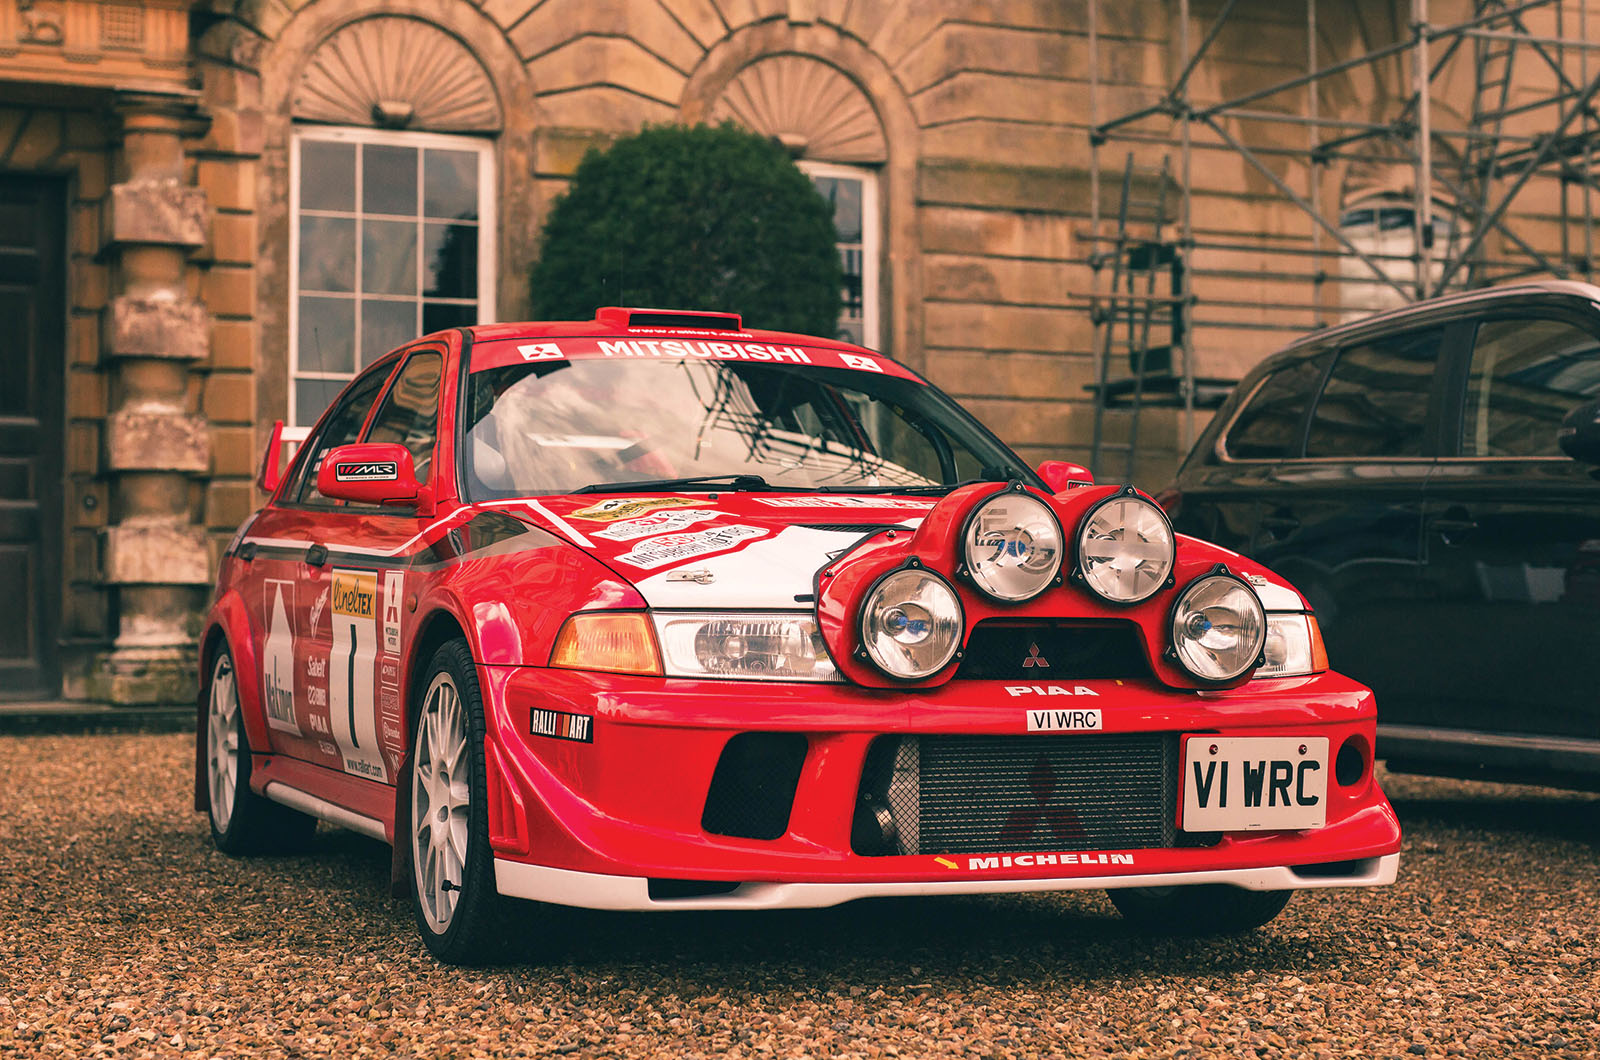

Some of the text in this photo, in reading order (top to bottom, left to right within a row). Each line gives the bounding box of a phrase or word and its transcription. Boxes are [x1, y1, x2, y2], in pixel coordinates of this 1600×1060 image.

[597, 341, 812, 364] MITSUBISHI
[348, 624, 360, 749] 1
[1004, 686, 1100, 696] PIAA
[1056, 711, 1097, 728] WRC
[1243, 760, 1320, 808] WRC
[968, 854, 1135, 870] MICHELIN
